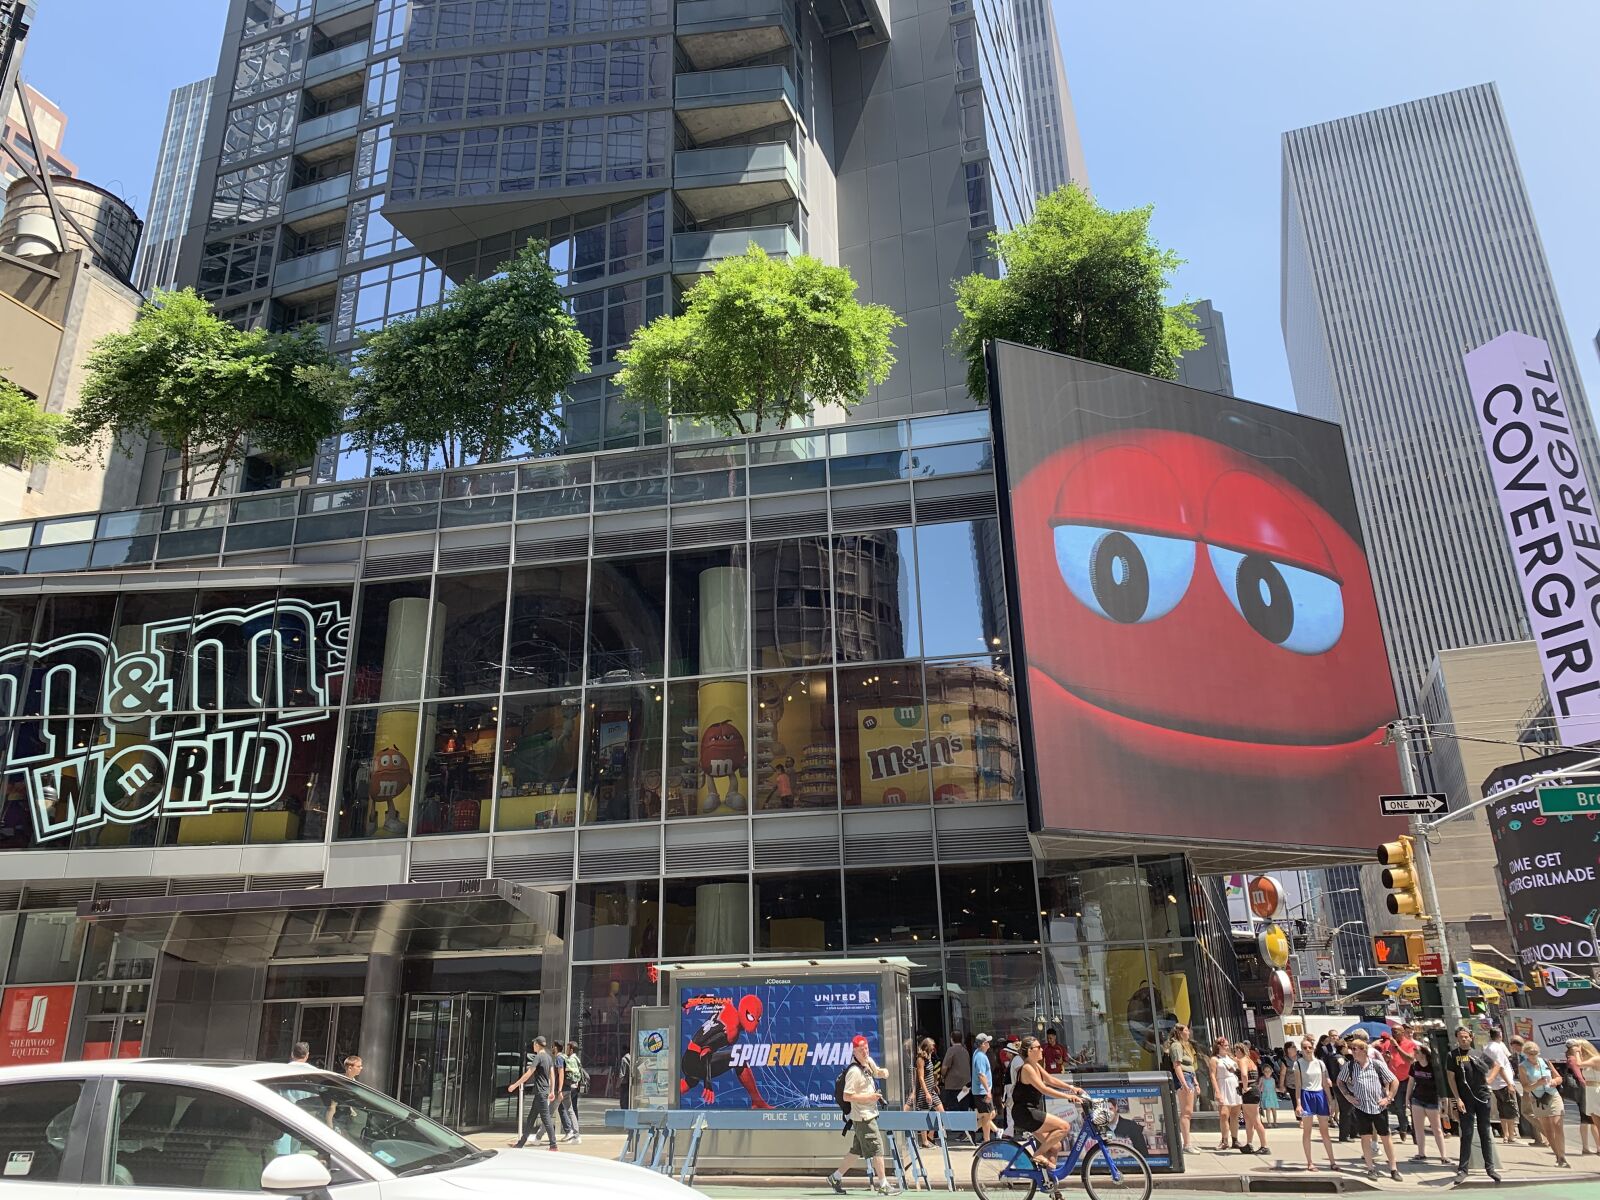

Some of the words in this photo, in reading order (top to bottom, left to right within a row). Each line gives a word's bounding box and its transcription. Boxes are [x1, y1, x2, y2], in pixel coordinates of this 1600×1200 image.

[1482, 383, 1600, 720] COVERGIRL
[30, 728, 293, 841] WORLD
[1390, 801, 1410, 810] ONE
[1416, 799, 1437, 809] WAY
[1534, 852, 1562, 868] GET
[1532, 941, 1572, 961] NOW
[814, 993, 857, 1002] UNITED
[1550, 1023, 1566, 1032] MIX
[1567, 1020, 1579, 1029] UP
[9, 1038, 56, 1048] SHERWOOD
[1548, 1030, 1591, 1044] MORNINGS
[11, 1047, 50, 1059] EQUITIES
[809, 1093, 819, 1101] fly
[820, 1093, 833, 1101] like
[762, 1113, 788, 1121] POLICE
[793, 1112, 809, 1121] LINE
[833, 1112, 843, 1121] NO
